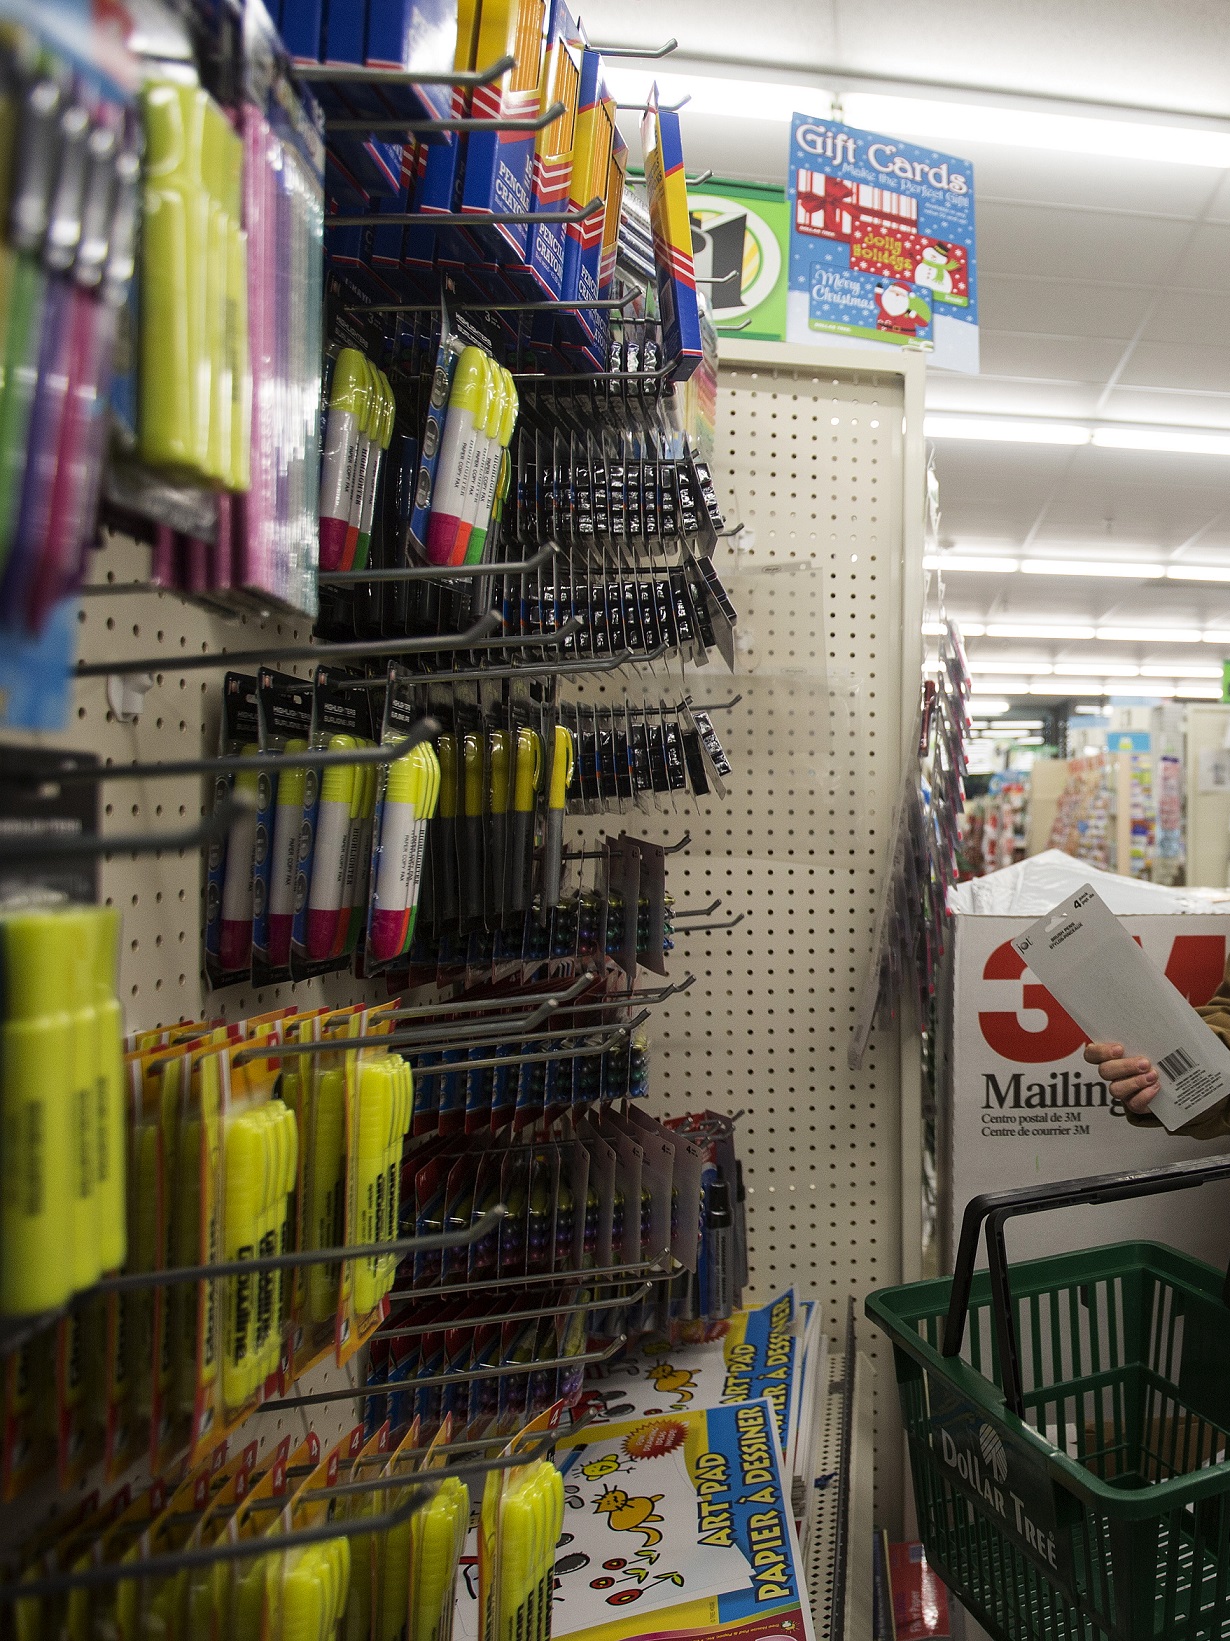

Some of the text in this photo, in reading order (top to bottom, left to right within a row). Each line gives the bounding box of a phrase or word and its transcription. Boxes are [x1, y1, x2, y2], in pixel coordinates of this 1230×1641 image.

[795, 124, 969, 195] Gift Cards
[853, 243, 913, 271] Holidays
[864, 232, 903, 256] Jolly
[815, 269, 861, 295] Merry
[812, 284, 876, 310] Christmas
[356, 448, 367, 505] HIGHLIGHTER
[347, 828, 359, 885] HIGHLIGHTER
[1073, 900, 1082, 909] 4
[981, 1112, 1081, 1126] Centro postal de 3M
[981, 1124, 1090, 1138] Centre de courrier 3M
[726, 1343, 756, 1373] PAD
[696, 1451, 737, 1547] ART PAD
[737, 1404, 794, 1603] PAPIER À DESSINER
[1009, 1490, 1059, 1571] TREE
